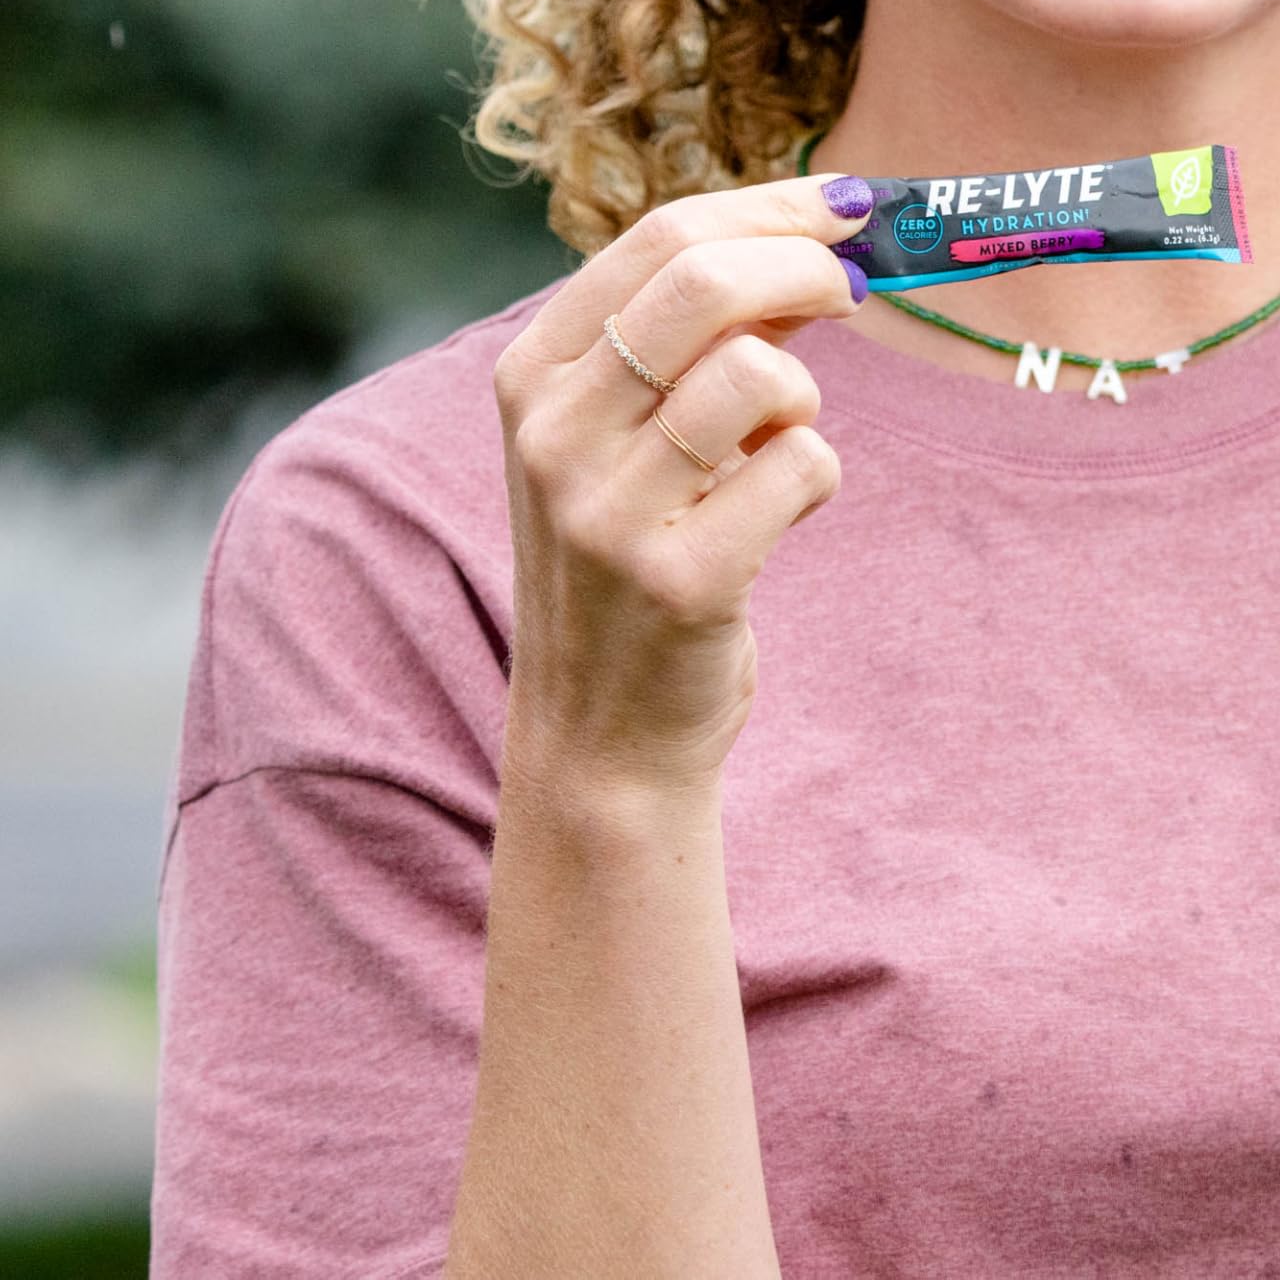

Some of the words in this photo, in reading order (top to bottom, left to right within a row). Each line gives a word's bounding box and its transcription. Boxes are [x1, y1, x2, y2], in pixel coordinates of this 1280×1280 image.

[926, 164, 1106, 218] RE-LYTE
[900, 219, 936, 231] ZERO
[1168, 226, 1183, 234] Net
[899, 230, 938, 240] CALORIES
[1163, 235, 1183, 245] 0.22
[1198, 233, 1221, 245] (6.3g)
[979, 240, 1026, 256] MIXED
[1030, 236, 1075, 251] BERRY
